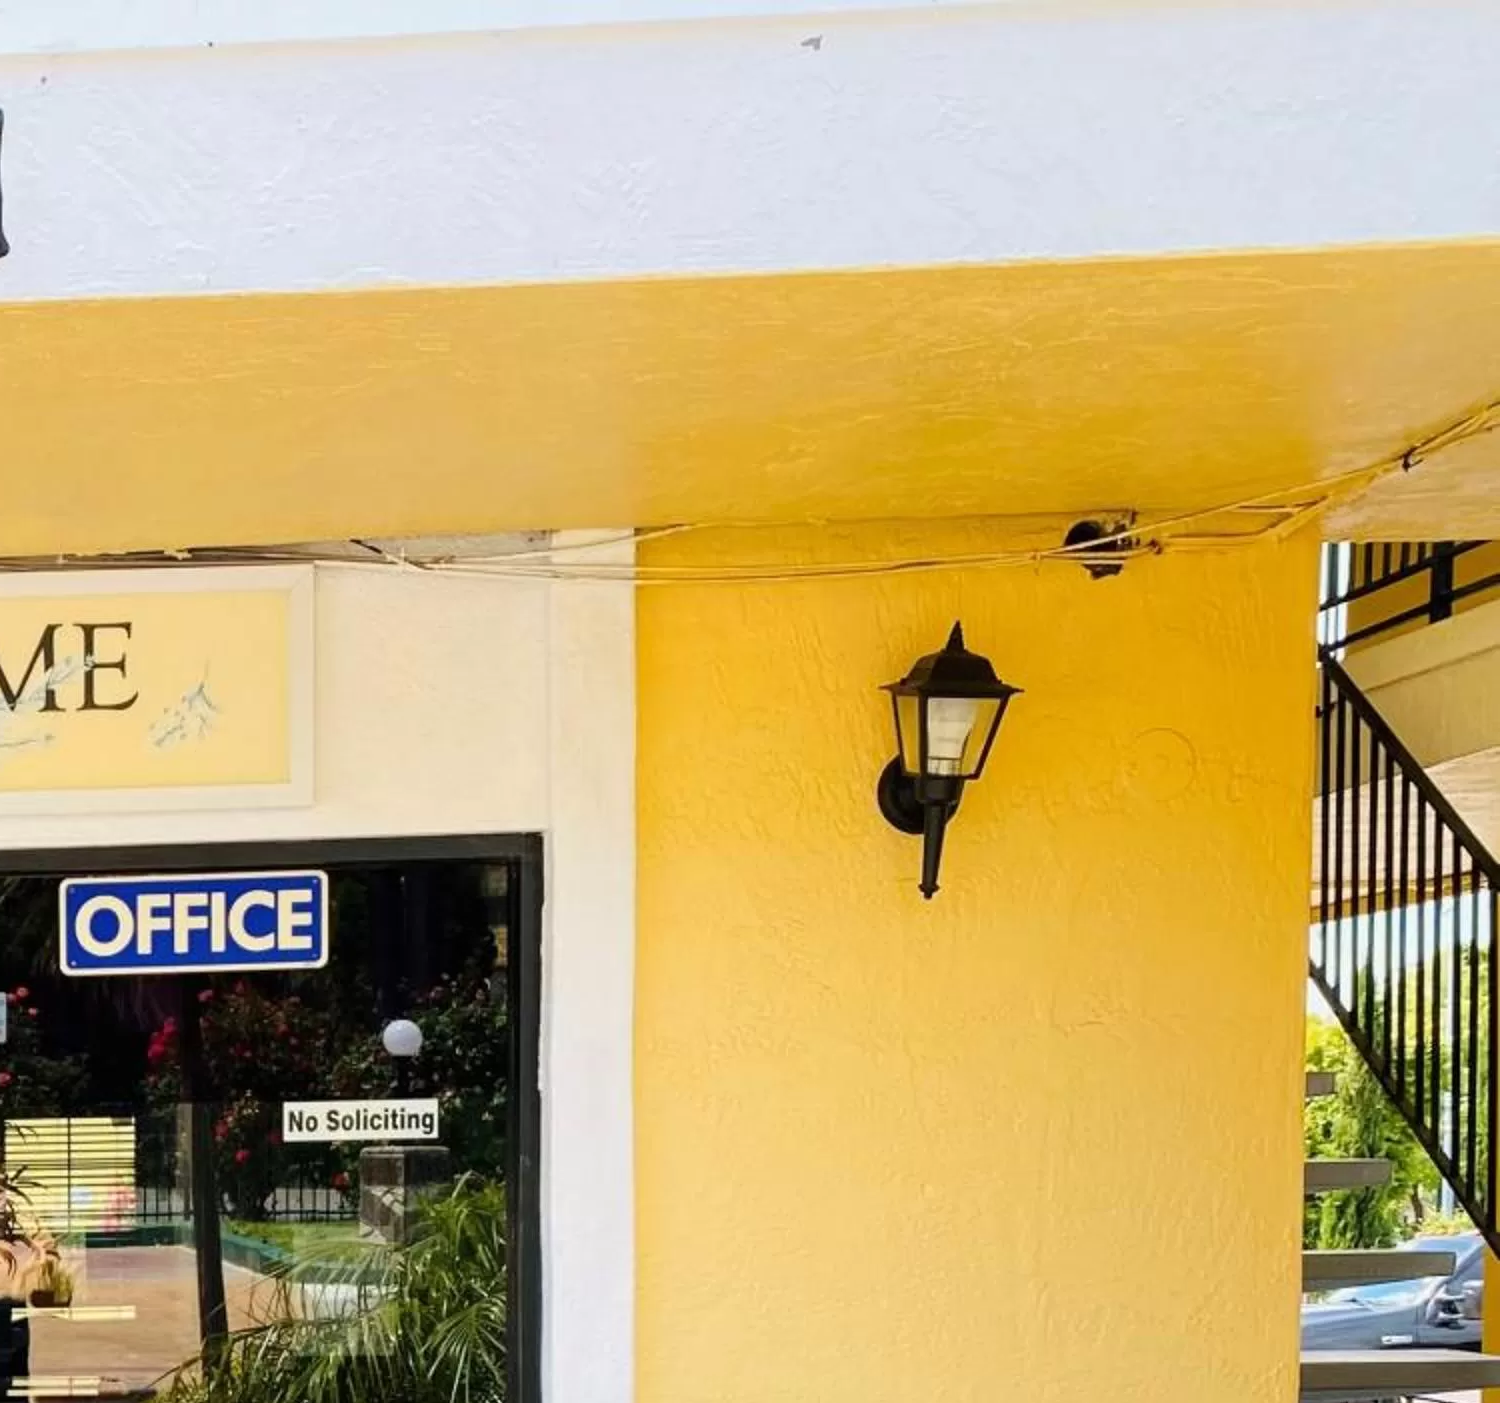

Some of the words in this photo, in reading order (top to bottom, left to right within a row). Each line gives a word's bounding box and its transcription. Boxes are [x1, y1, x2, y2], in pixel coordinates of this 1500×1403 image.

[75, 889, 313, 957] OFFICE
[288, 1110, 318, 1133] No
[326, 1107, 435, 1135] Soliciting
